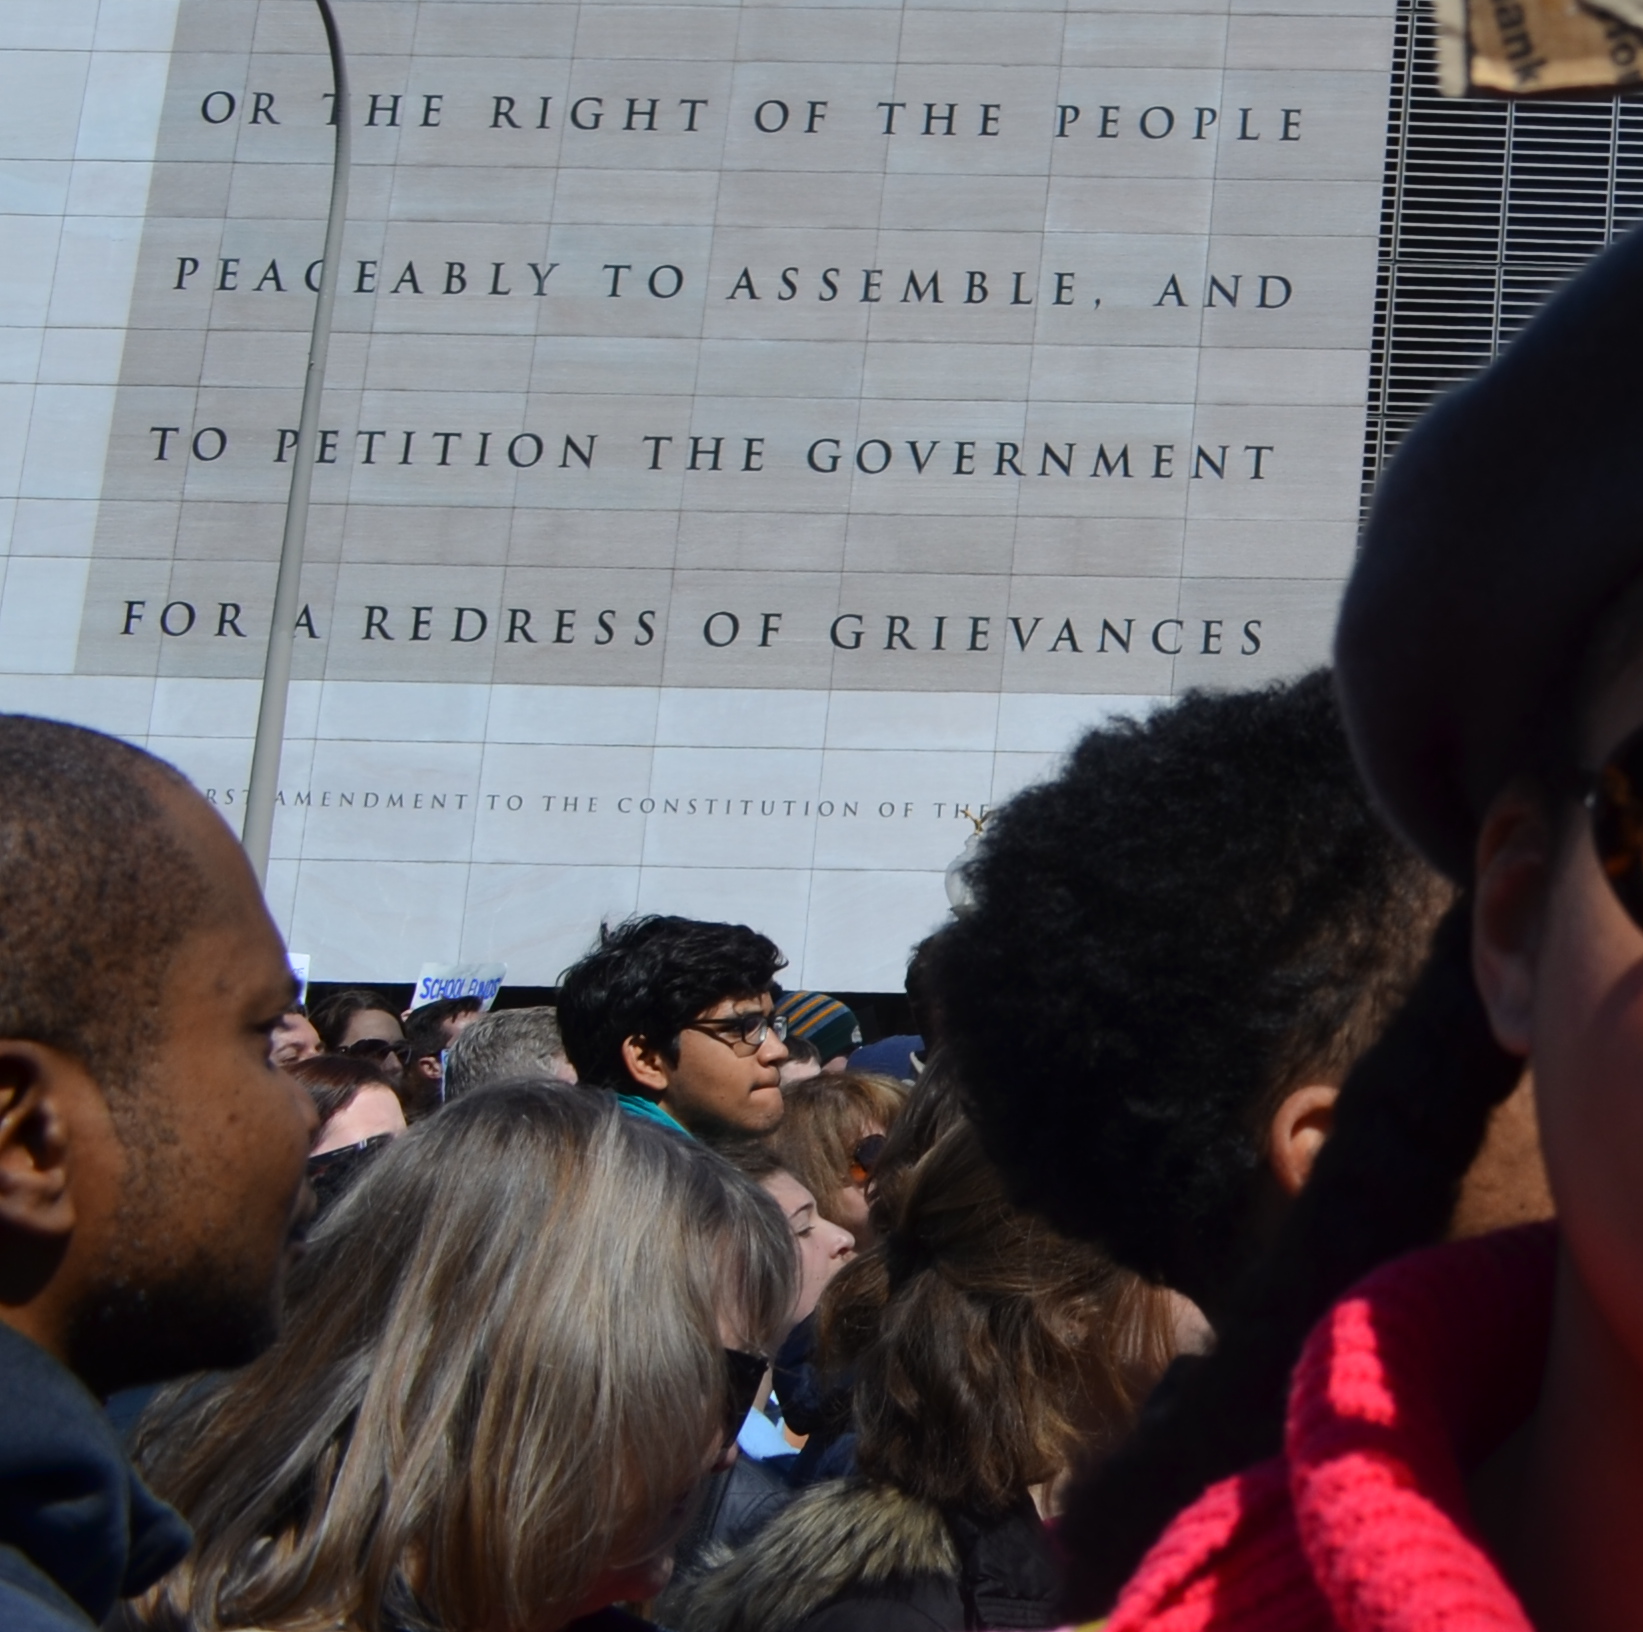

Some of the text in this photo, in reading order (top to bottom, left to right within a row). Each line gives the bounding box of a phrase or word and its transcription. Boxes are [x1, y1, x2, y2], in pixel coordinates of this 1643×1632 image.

[199, 89, 1303, 143] OR THE RIGHT OF THE PEOPLE
[171, 255, 1294, 310] PEACEABLY TO ASSEMBLE, AND
[148, 425, 1276, 481] TO PETITION THE GOVERNMENT
[118, 599, 1263, 657] FOR A REDRESS OF GRIEVANCES
[274, 790, 990, 819] AMENDMENT TO THE CONSTITUTION OF THE
